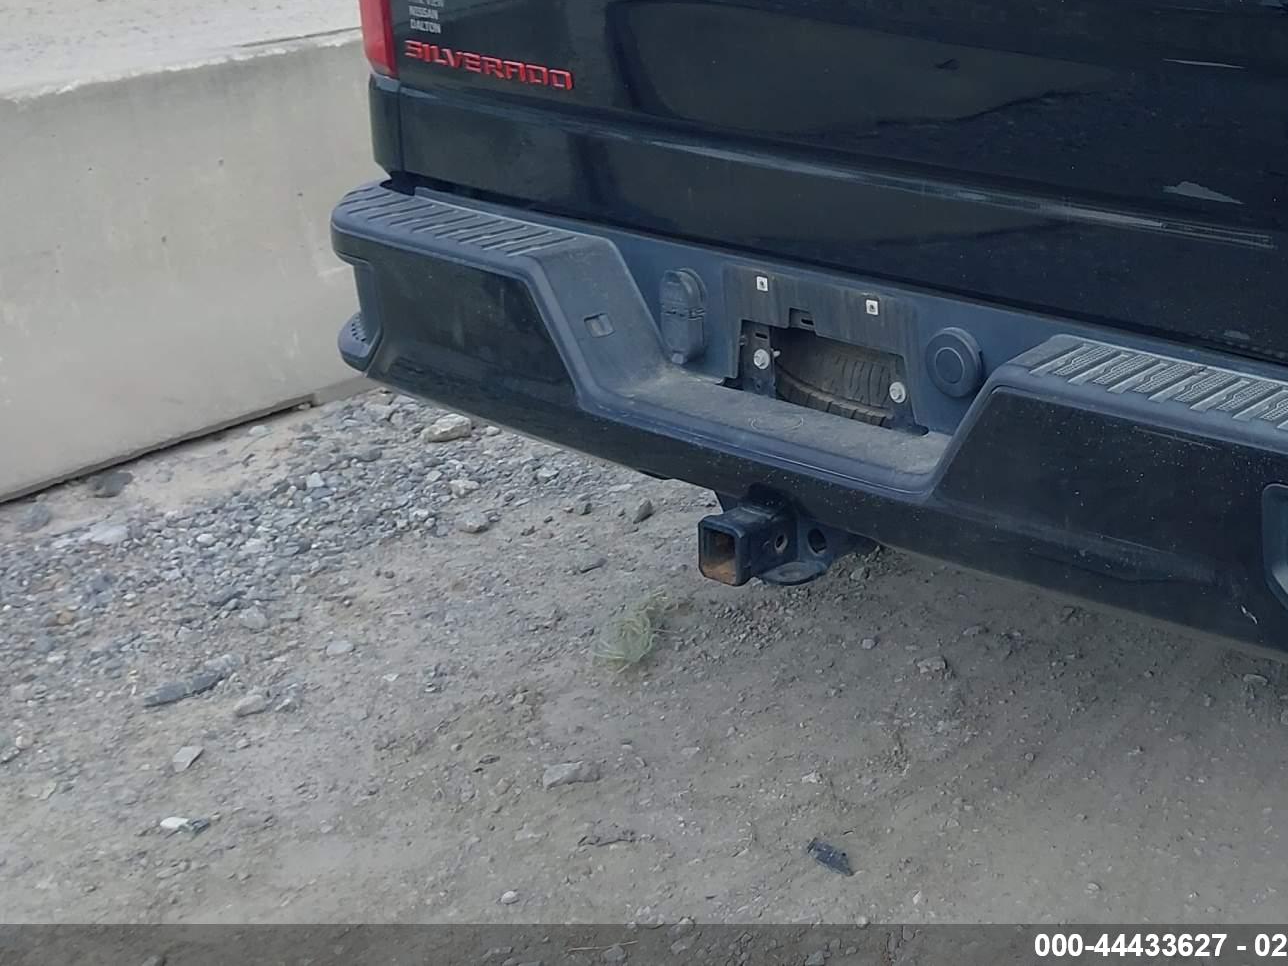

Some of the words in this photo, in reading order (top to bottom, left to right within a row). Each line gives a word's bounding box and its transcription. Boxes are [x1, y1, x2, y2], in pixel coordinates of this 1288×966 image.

[408, 5, 439, 20] NISSAN
[409, 18, 442, 34] DALTON
[403, 39, 575, 92] SILVERADO
